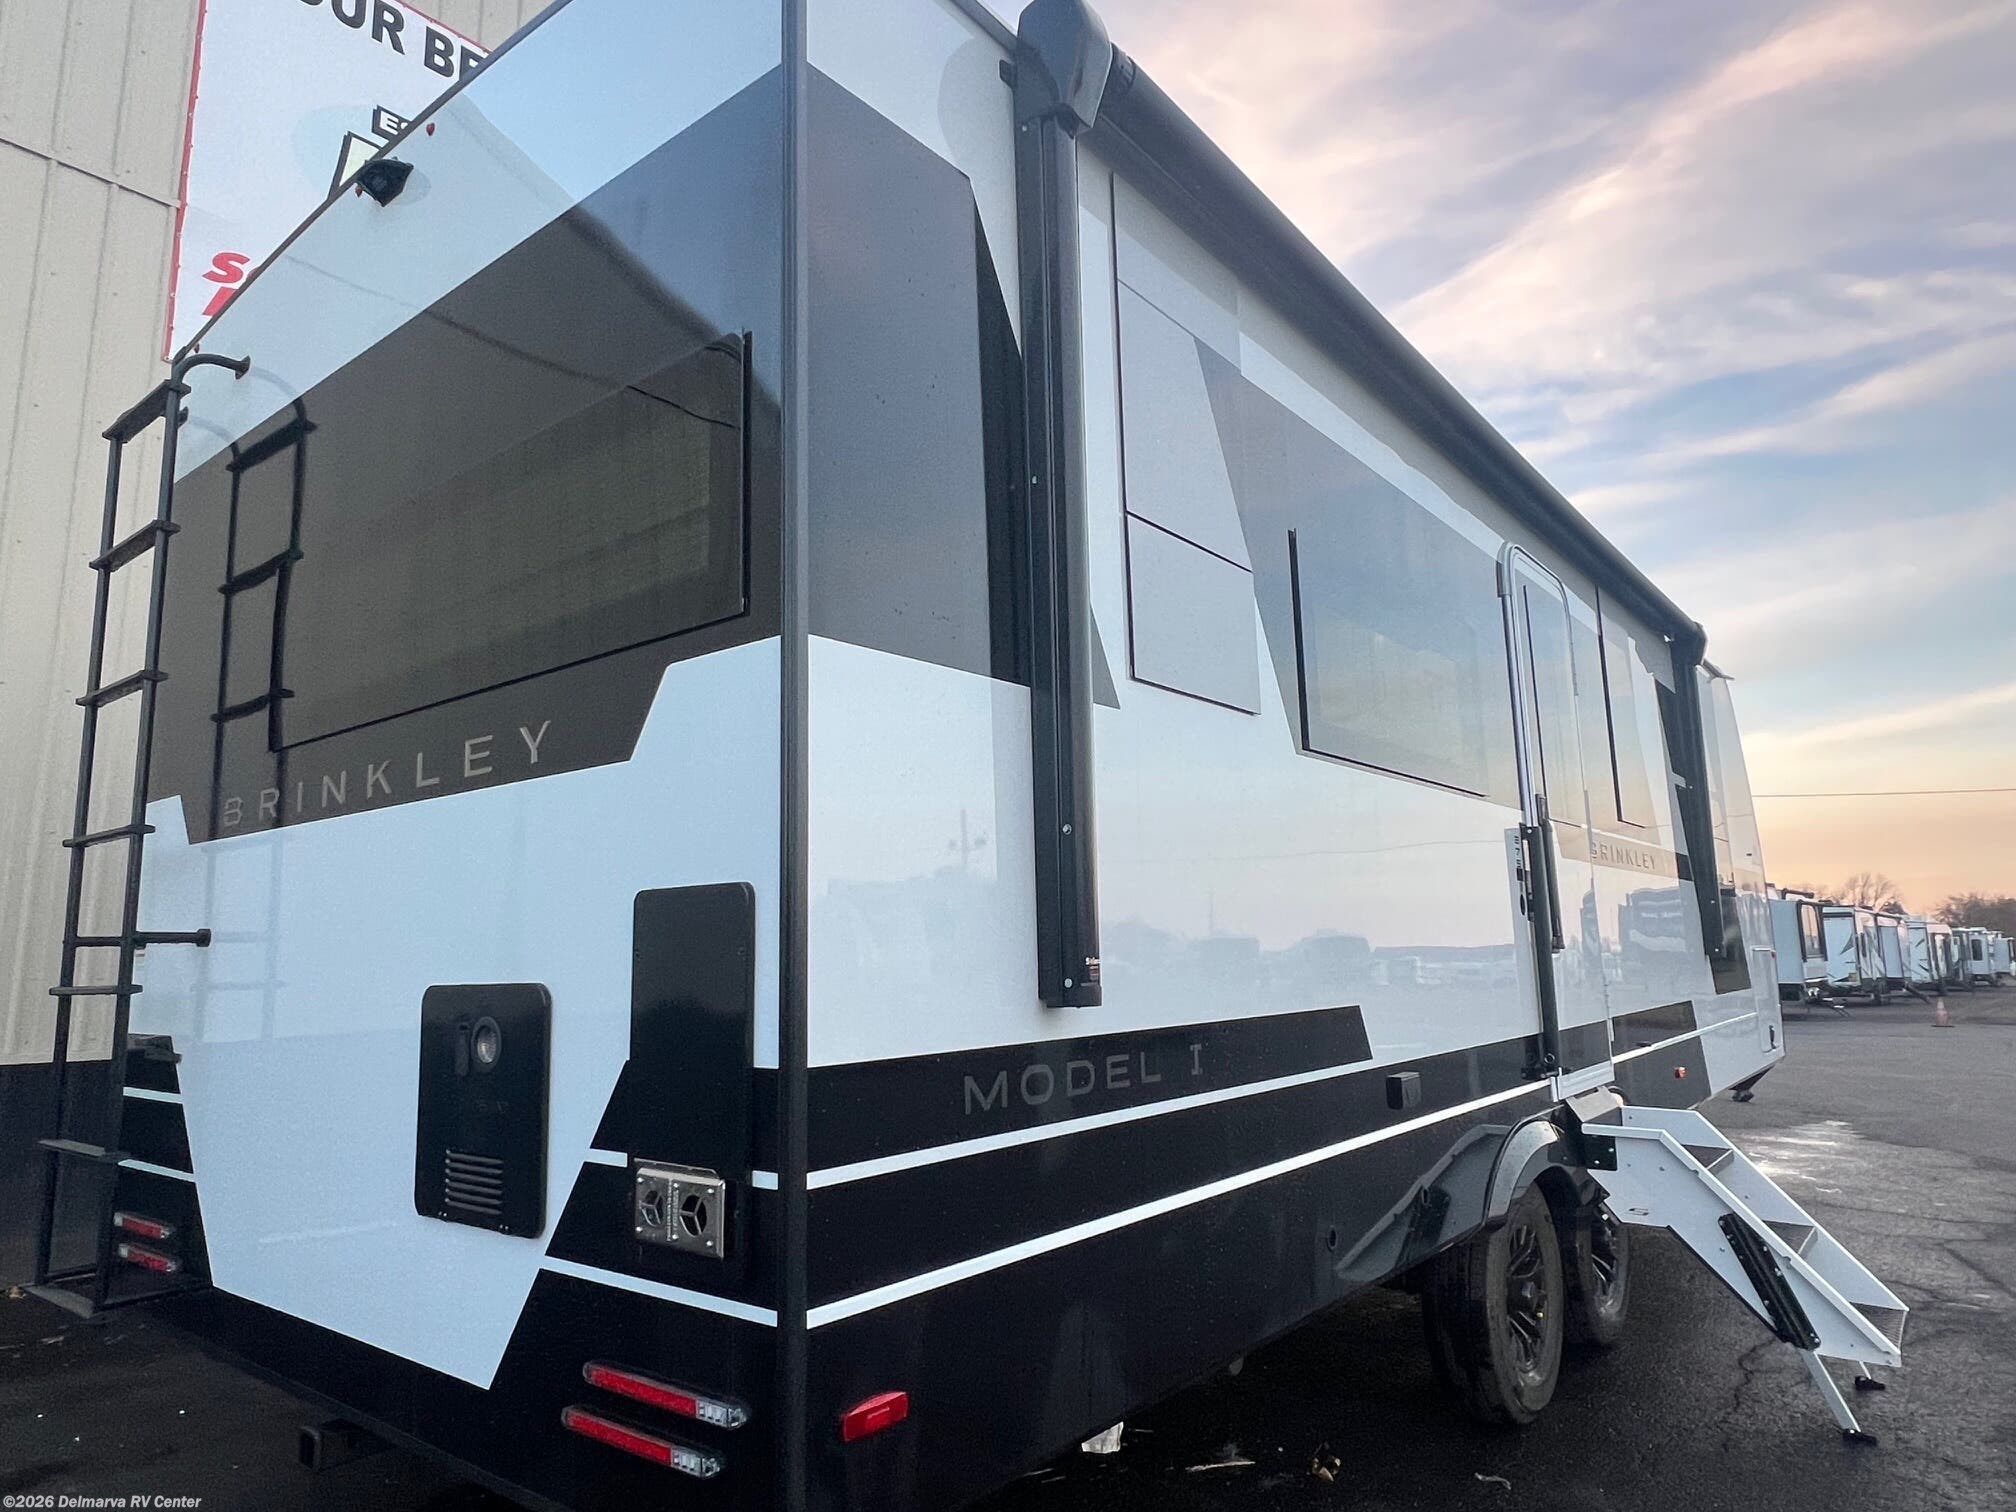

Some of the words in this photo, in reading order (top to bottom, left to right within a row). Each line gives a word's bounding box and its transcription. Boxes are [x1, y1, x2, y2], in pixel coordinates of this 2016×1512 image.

[300, 0, 405, 55] UR
[223, 719, 552, 829] BRINKLEY
[1590, 841, 1657, 870] BRINKLEY
[963, 1051, 1162, 1116] MODEL
[1189, 1043, 1203, 1076] I
